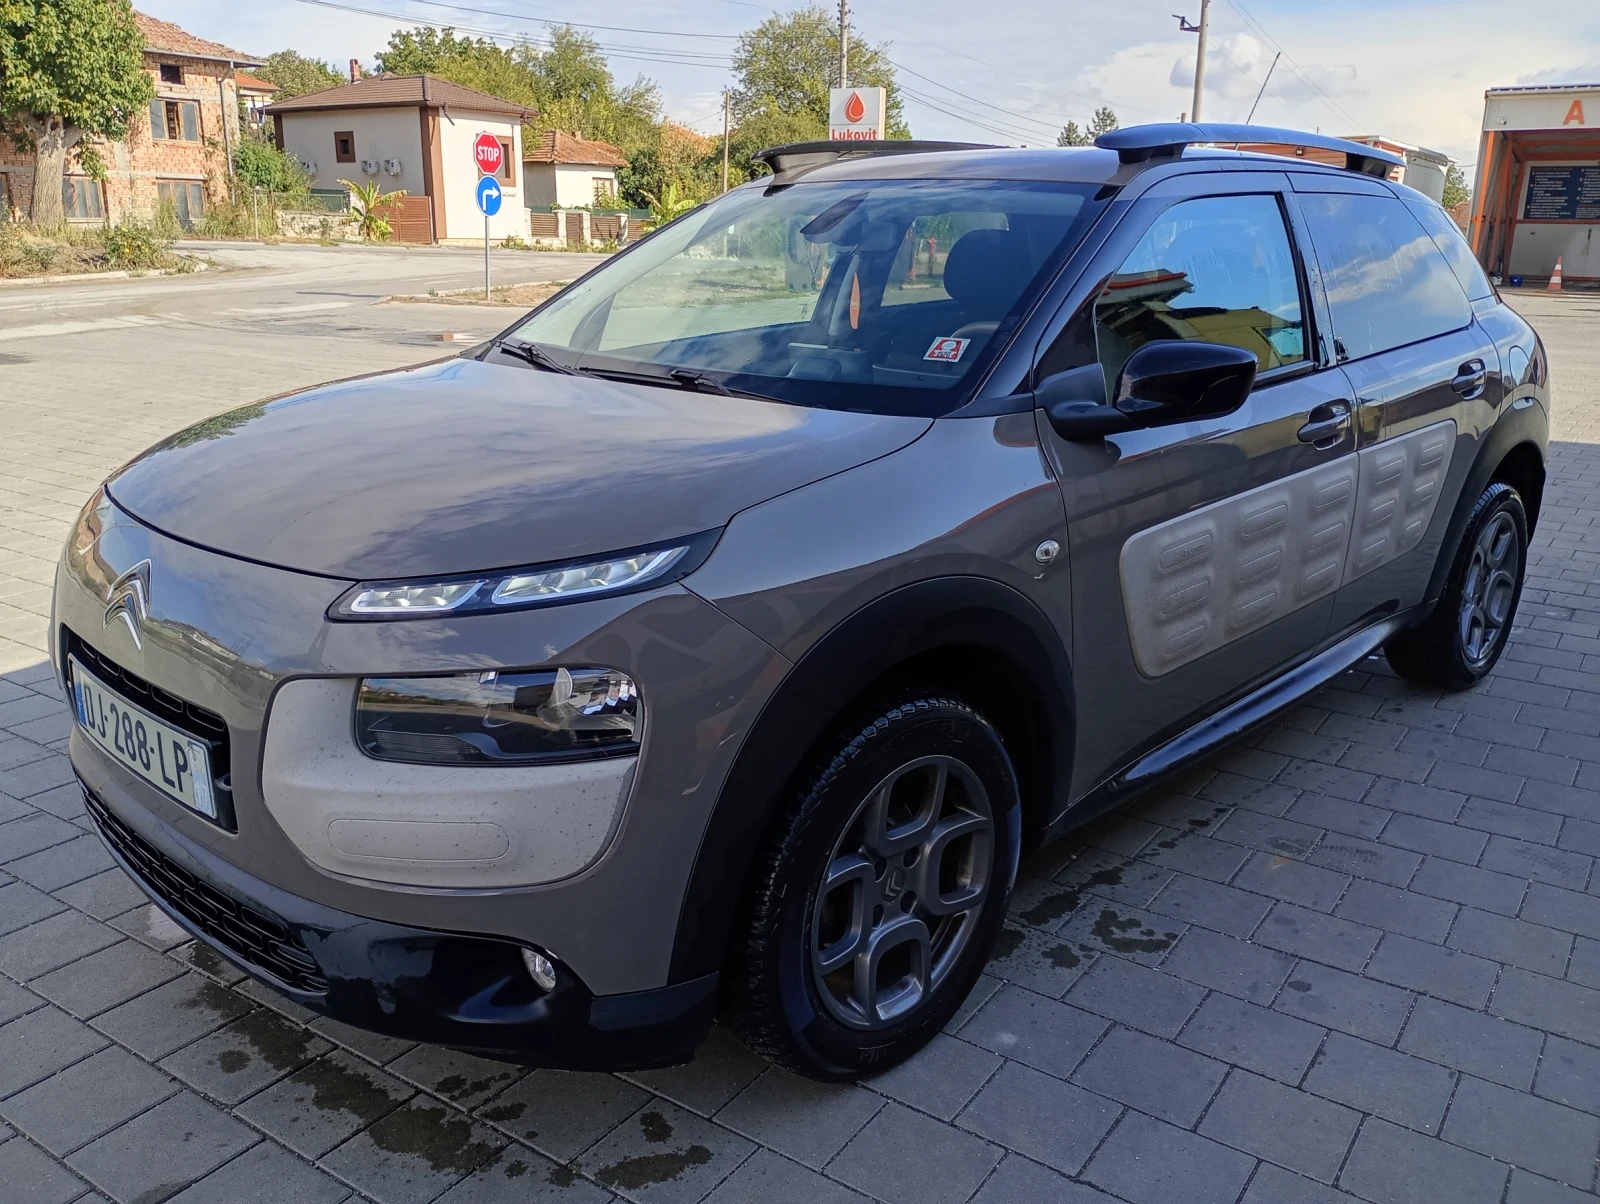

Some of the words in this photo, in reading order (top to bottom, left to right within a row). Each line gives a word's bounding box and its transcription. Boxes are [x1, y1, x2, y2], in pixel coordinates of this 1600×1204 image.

[1562, 99, 1585, 125] A
[831, 127, 877, 140] Lukovit
[477, 145, 500, 162] STOP
[83, 682, 189, 793] DJ-288-LP
